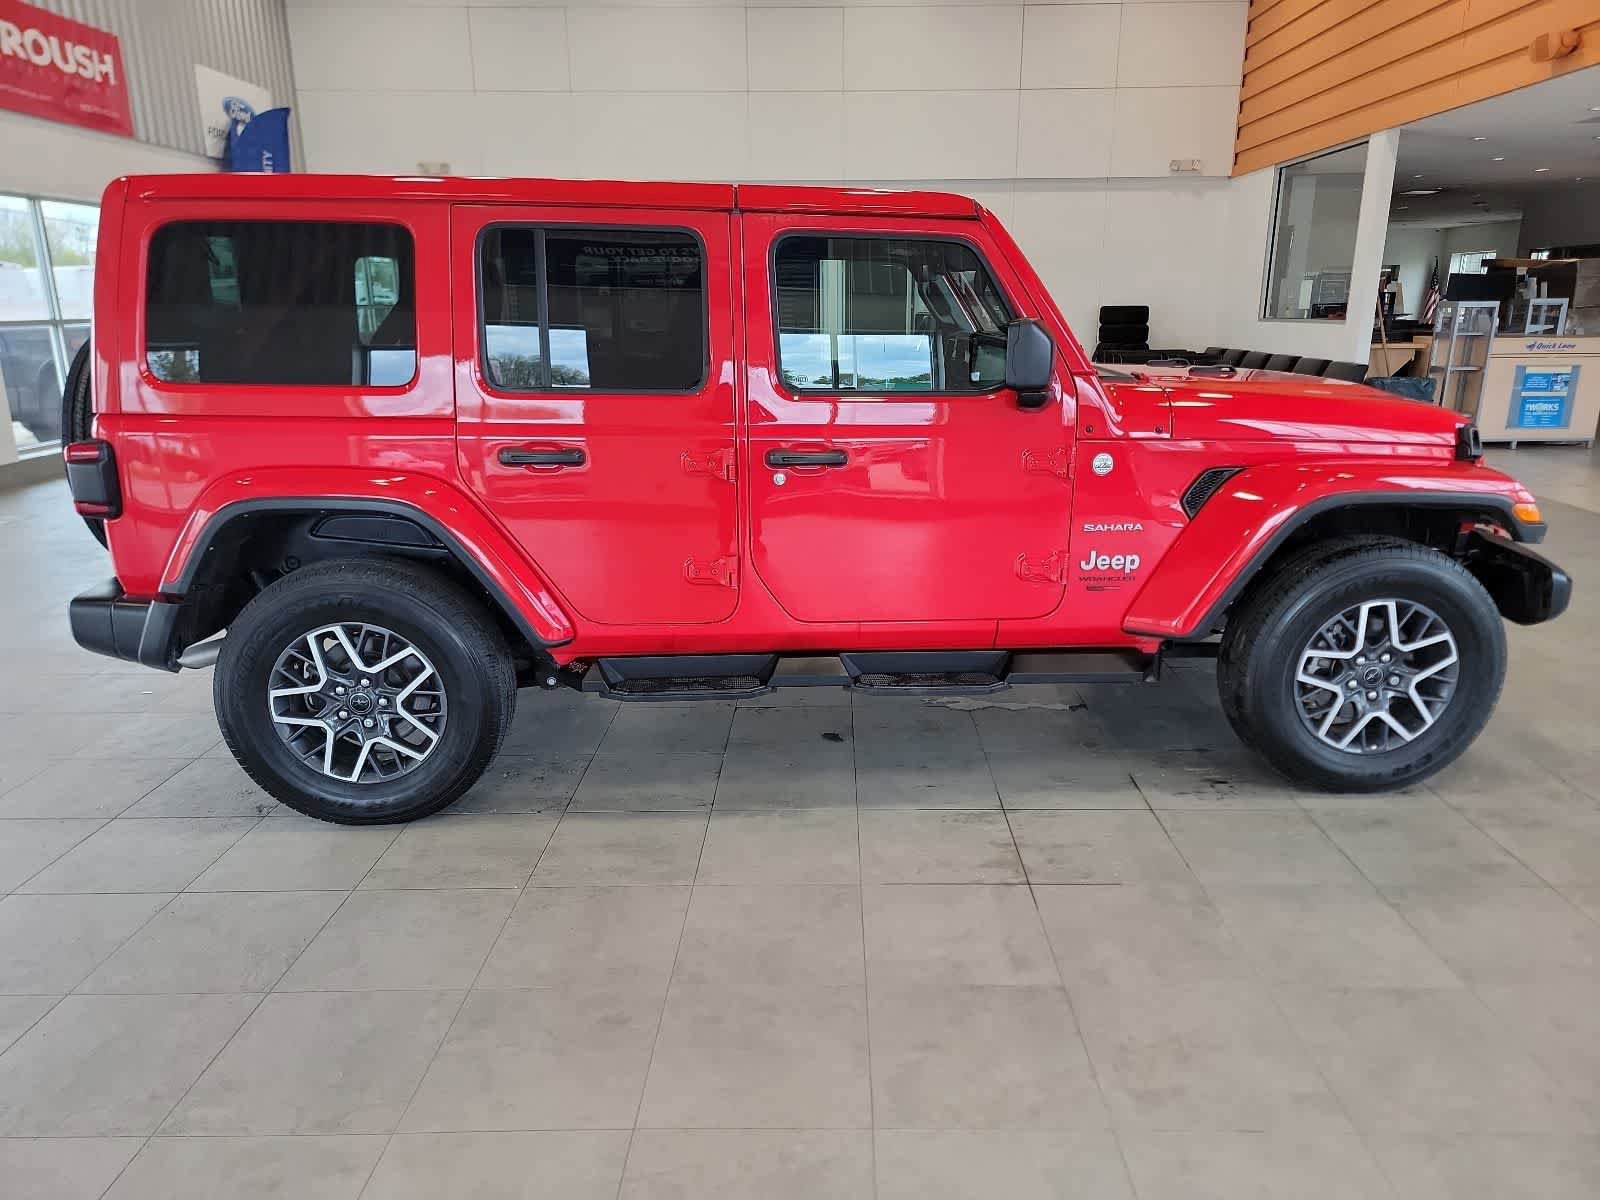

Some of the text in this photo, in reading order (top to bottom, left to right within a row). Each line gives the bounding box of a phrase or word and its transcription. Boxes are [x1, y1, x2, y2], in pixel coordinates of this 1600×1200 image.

[0, 19, 114, 85] ROUSH
[1083, 523, 1144, 532] SAHARA
[1080, 550, 1141, 574] Jeep
